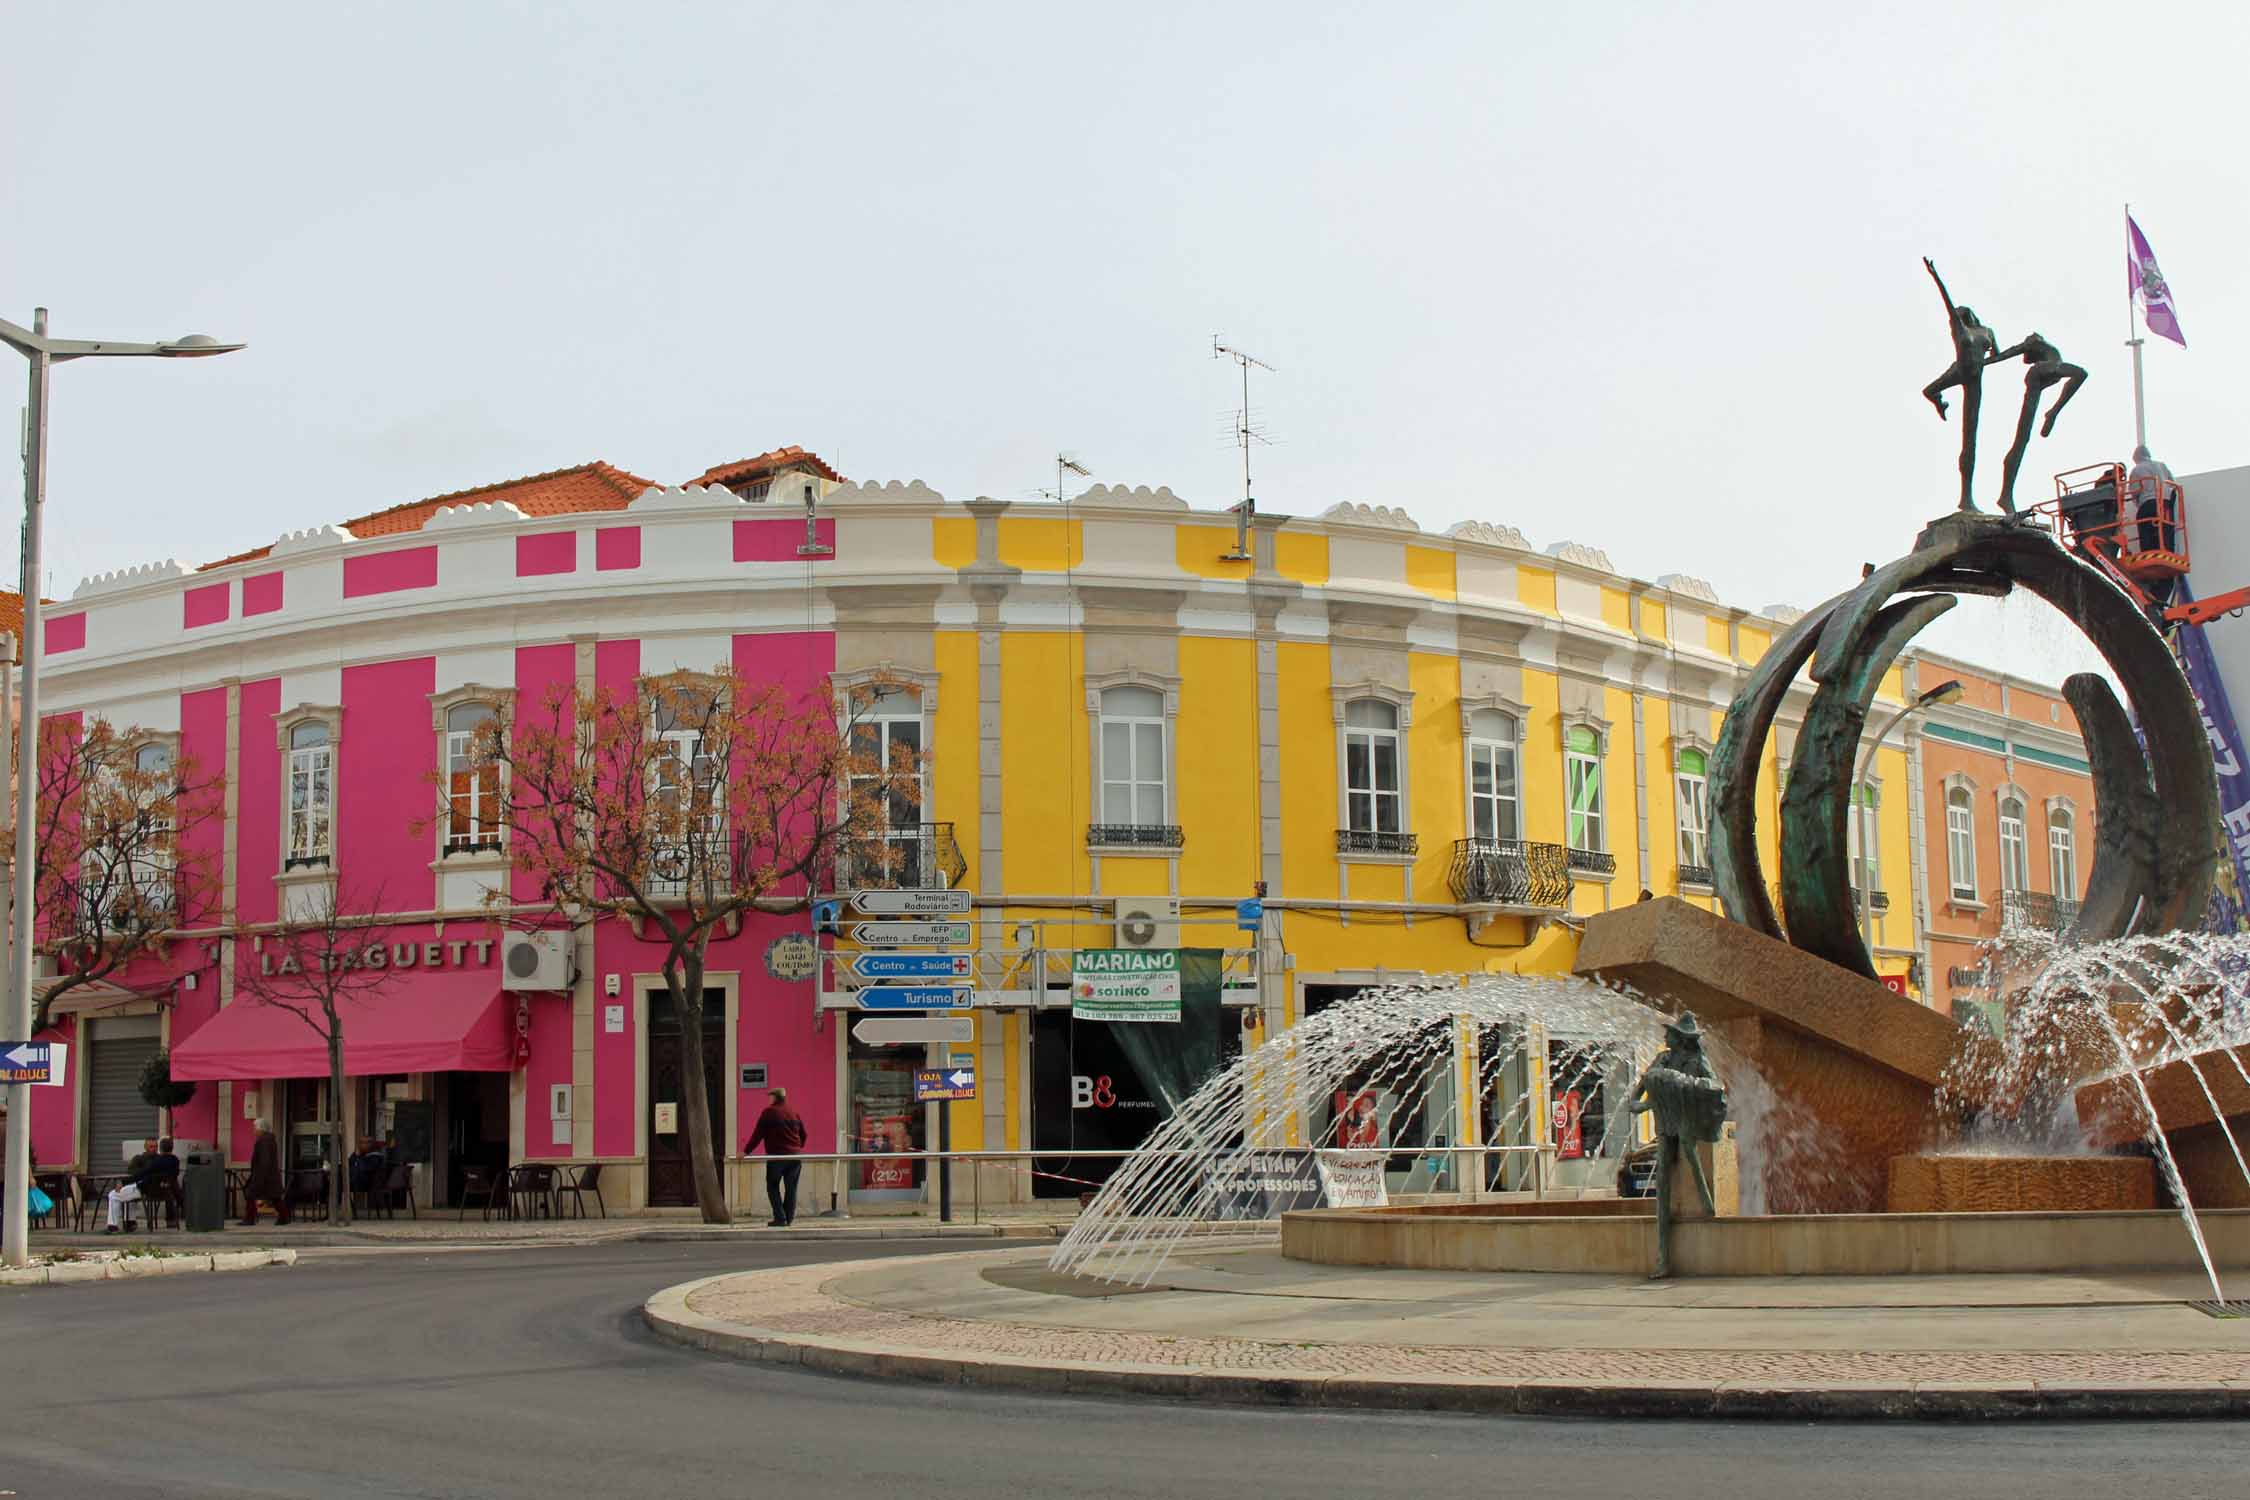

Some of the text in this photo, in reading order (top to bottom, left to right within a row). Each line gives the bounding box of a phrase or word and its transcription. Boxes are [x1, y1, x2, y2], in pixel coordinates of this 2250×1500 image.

[931, 926, 950, 934] IEFP
[912, 935, 950, 943] Emprego
[262, 952, 300, 976] LA
[871, 960, 906, 970] Centro
[920, 960, 952, 970] Saúde
[1076, 952, 1175, 970] MARIANO
[903, 991, 952, 1005] Turismo
[918, 1073, 942, 1081] LOJA
[1072, 1075, 1155, 1109] B& PERFUMES
[1226, 1178, 1318, 1193] PROFESSORES
